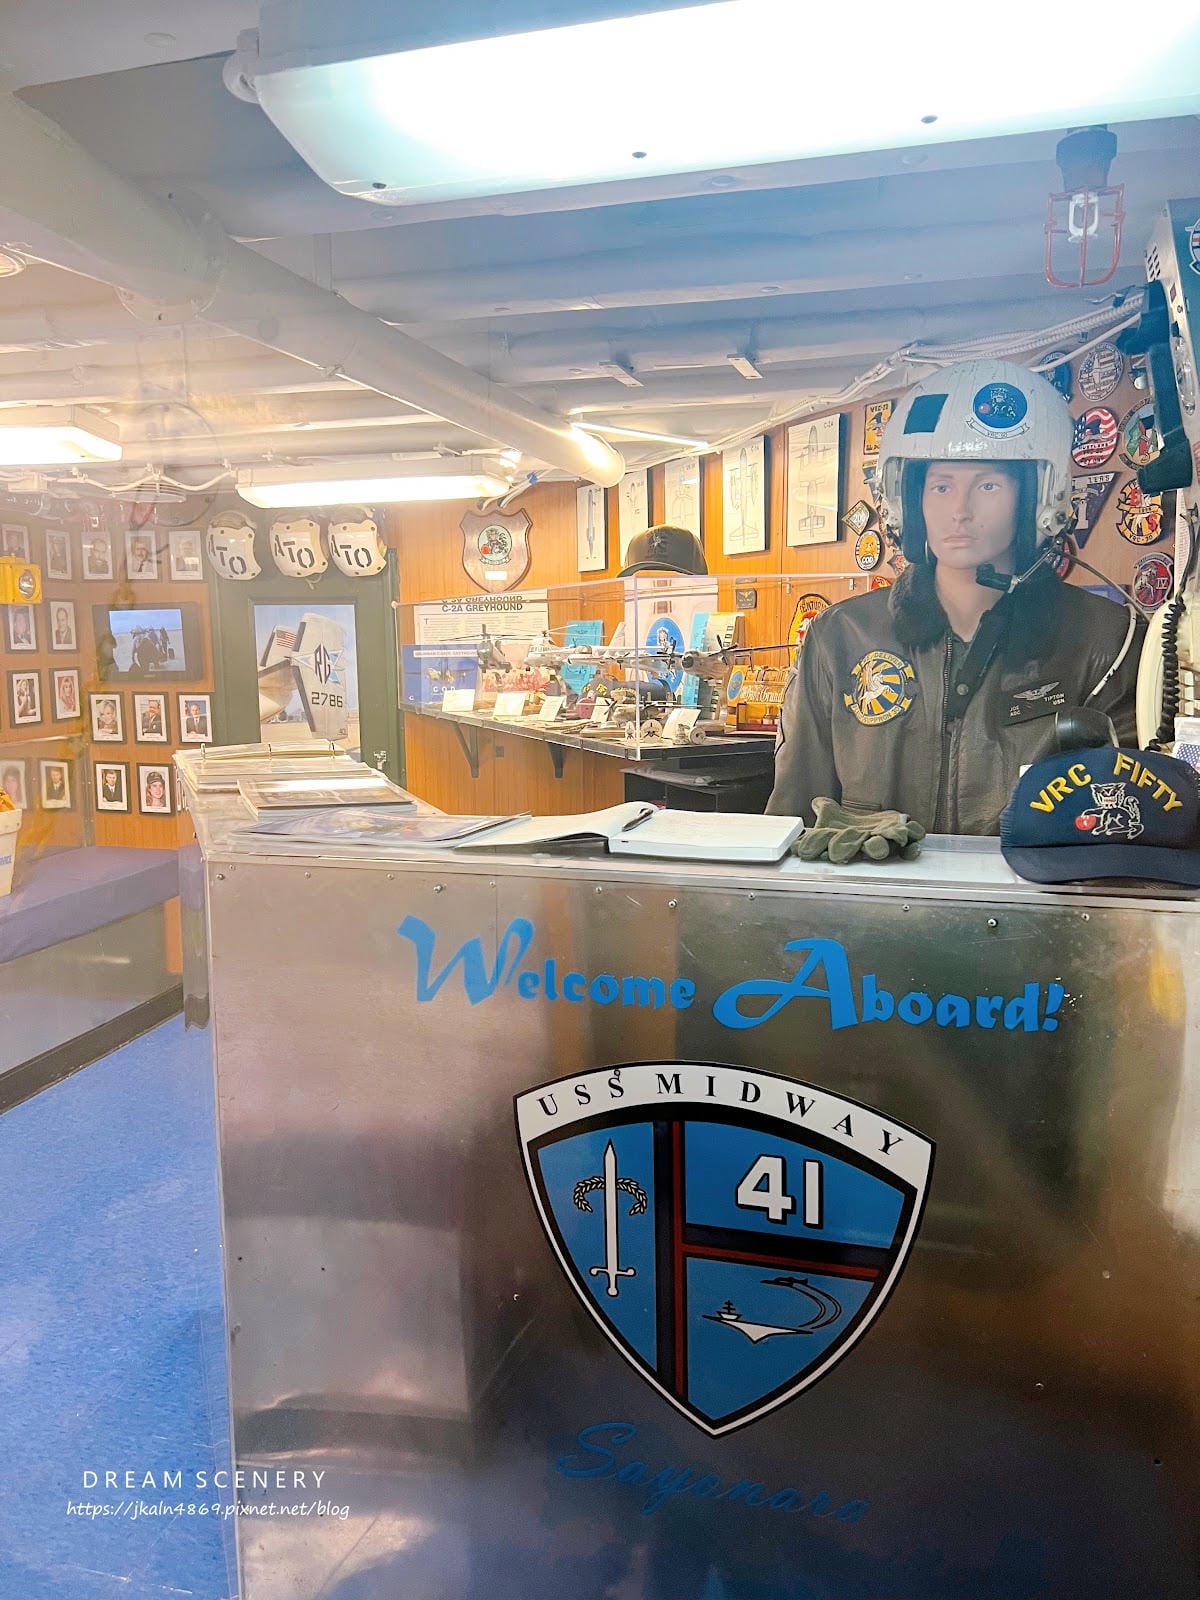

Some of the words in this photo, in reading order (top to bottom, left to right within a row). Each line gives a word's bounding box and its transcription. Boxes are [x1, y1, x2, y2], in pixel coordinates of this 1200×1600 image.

[274, 534, 315, 569] ATO
[330, 534, 373, 568] ATO
[441, 604, 463, 613] C-2A
[465, 602, 523, 612] GREYHOUND
[311, 691, 343, 708] 2786
[1029, 763, 1092, 813] VRC
[1113, 751, 1184, 812] FIFTY
[397, 914, 696, 1009] Welcome
[712, 937, 1066, 1033] Aboard!
[536, 1077, 626, 1117] USS
[656, 1072, 905, 1156] MIDWAY
[735, 1153, 825, 1230] 41
